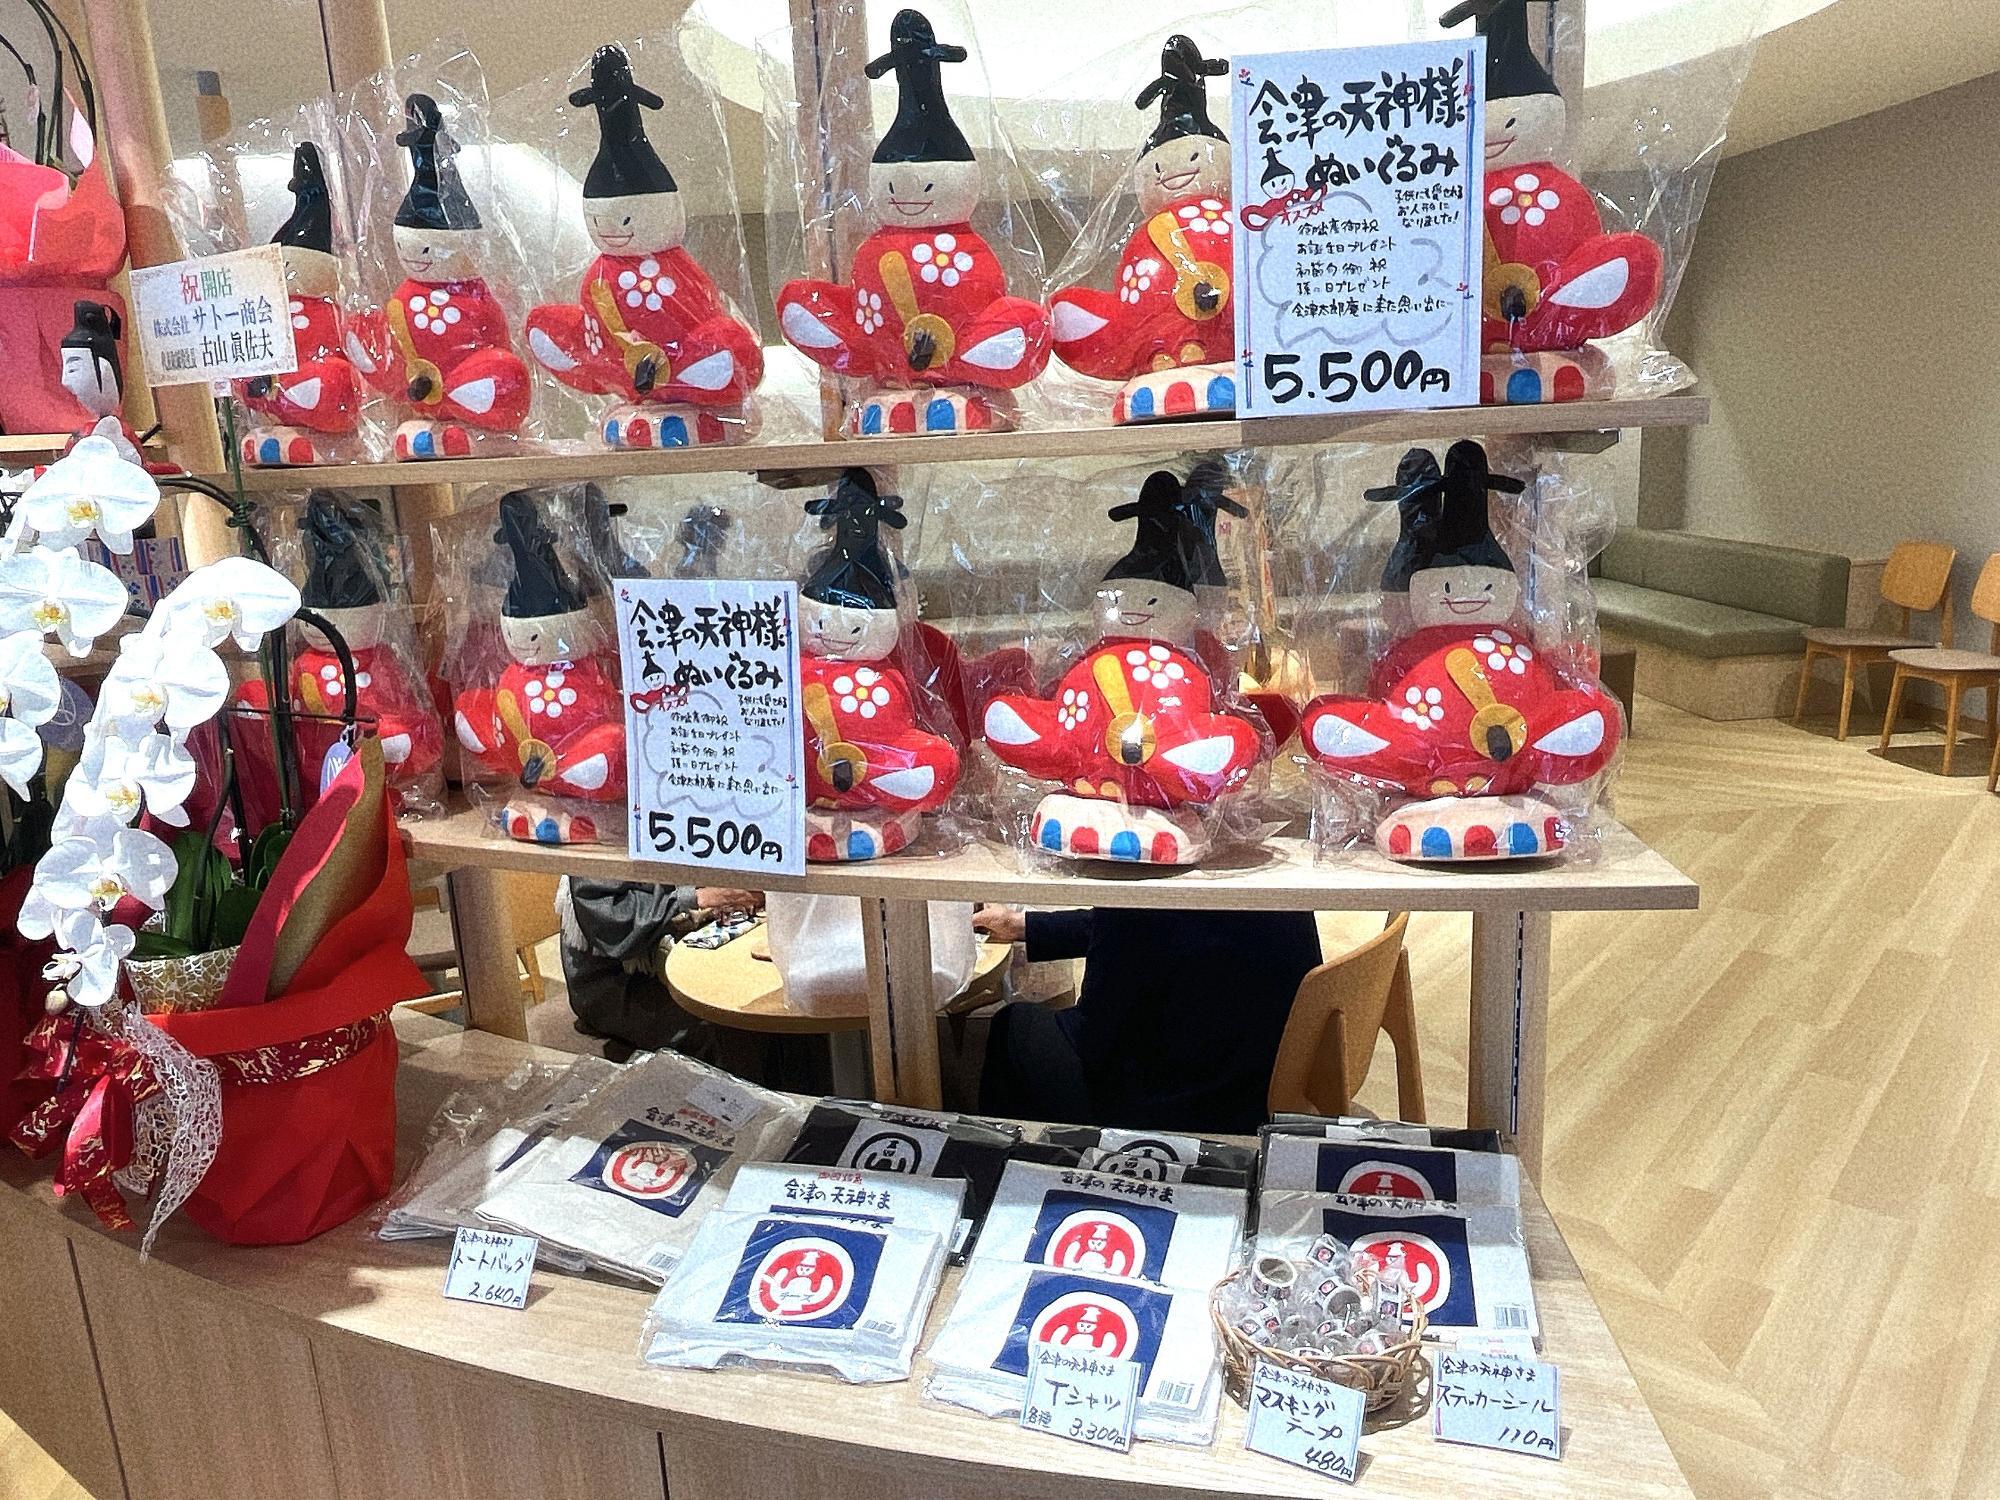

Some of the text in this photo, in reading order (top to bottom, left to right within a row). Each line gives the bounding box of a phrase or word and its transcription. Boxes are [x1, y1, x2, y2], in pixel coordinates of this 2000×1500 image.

[1249, 57, 1467, 149] 会津の天神様
[1305, 134, 1459, 187] ぬいぐるみ
[192, 295, 274, 331] サトー商会
[1263, 349, 1451, 404] 5.500円
[629, 594, 787, 656] 会津の天神様
[673, 651, 784, 690] ぬいぐるみ
[649, 810, 783, 863] 5.500円
[452, 1248, 533, 1274] トートバッグ
[1044, 1378, 1122, 1412] Tシャツ
[1255, 1384, 1336, 1418] マスキング
[1436, 1383, 1556, 1414] ステッカーシール
[1286, 1416, 1343, 1440] テープ
[1497, 1426, 1555, 1451] 110円
[1304, 1446, 1353, 1479] 480円
